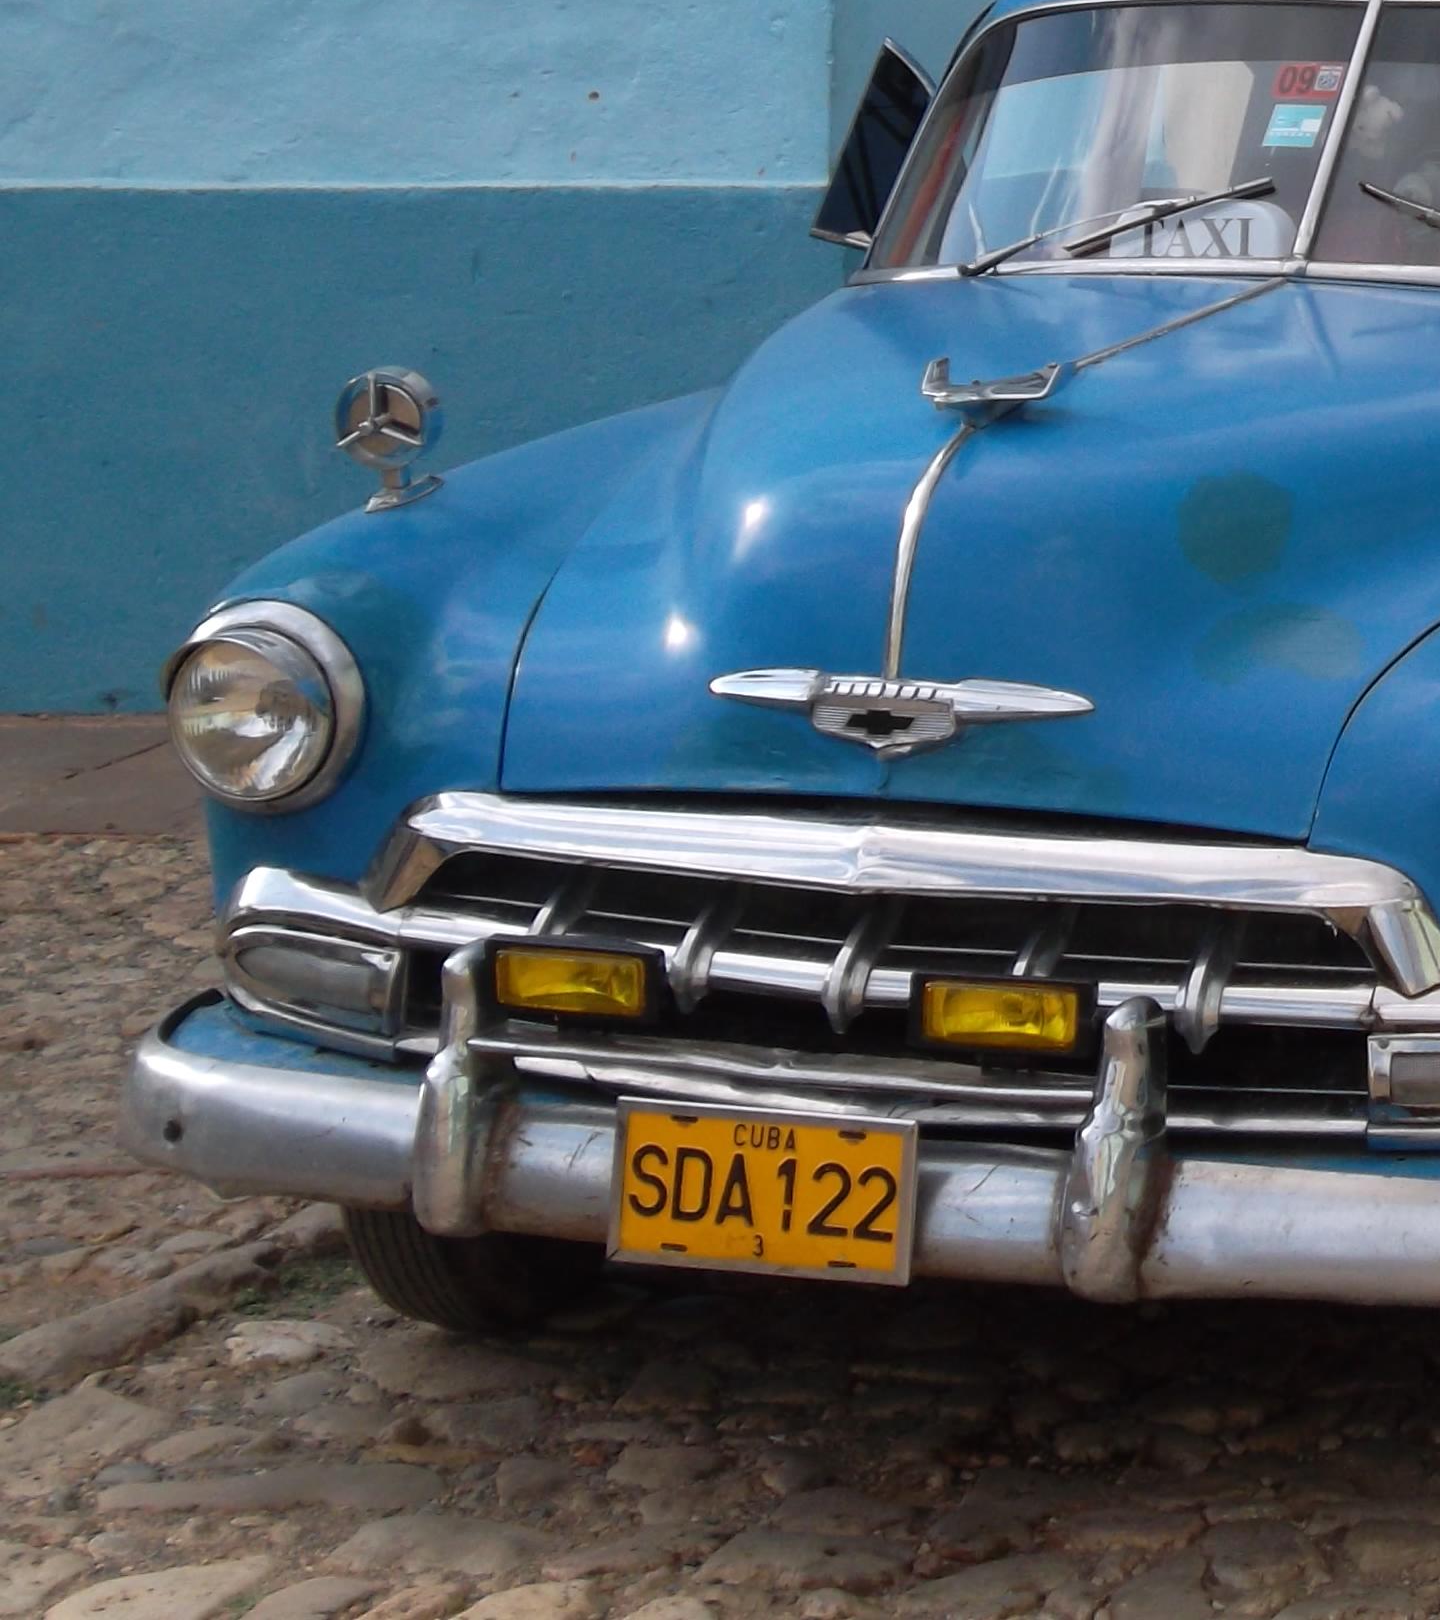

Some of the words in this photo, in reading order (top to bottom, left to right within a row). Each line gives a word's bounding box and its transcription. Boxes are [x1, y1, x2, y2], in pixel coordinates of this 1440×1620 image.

[1278, 66, 1316, 94] 09
[1141, 217, 1253, 257] TAXI
[733, 1123, 797, 1151] CUBA
[752, 1234, 765, 1257] 3
